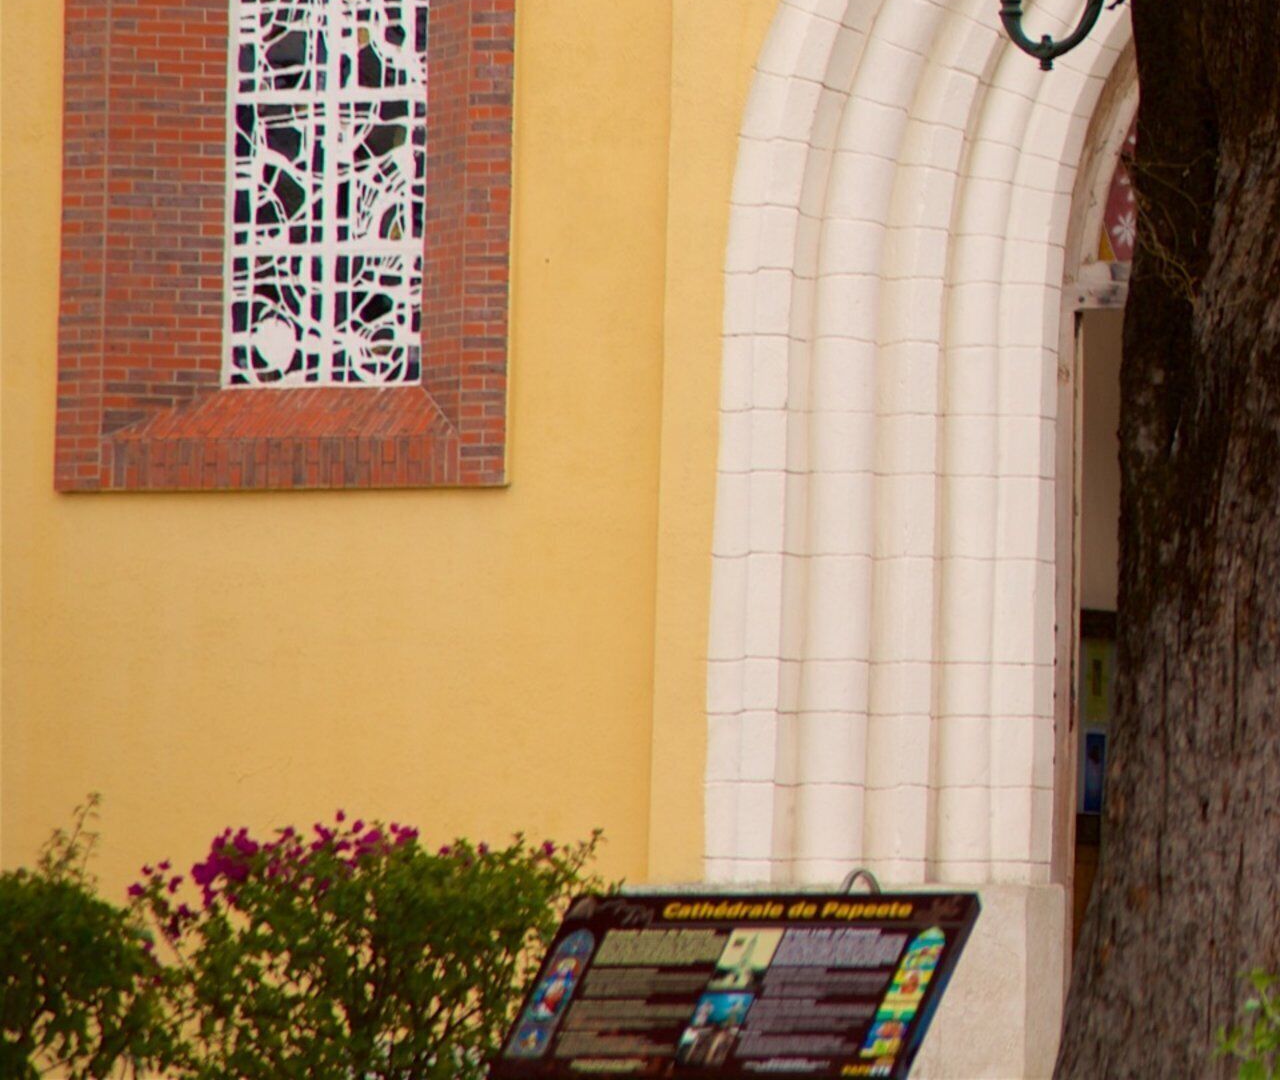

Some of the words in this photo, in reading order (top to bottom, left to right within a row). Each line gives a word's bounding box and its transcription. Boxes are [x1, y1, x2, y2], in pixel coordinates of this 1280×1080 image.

[662, 900, 784, 919] Cathédrale
[787, 900, 817, 919] de
[820, 900, 913, 921] Papeete
